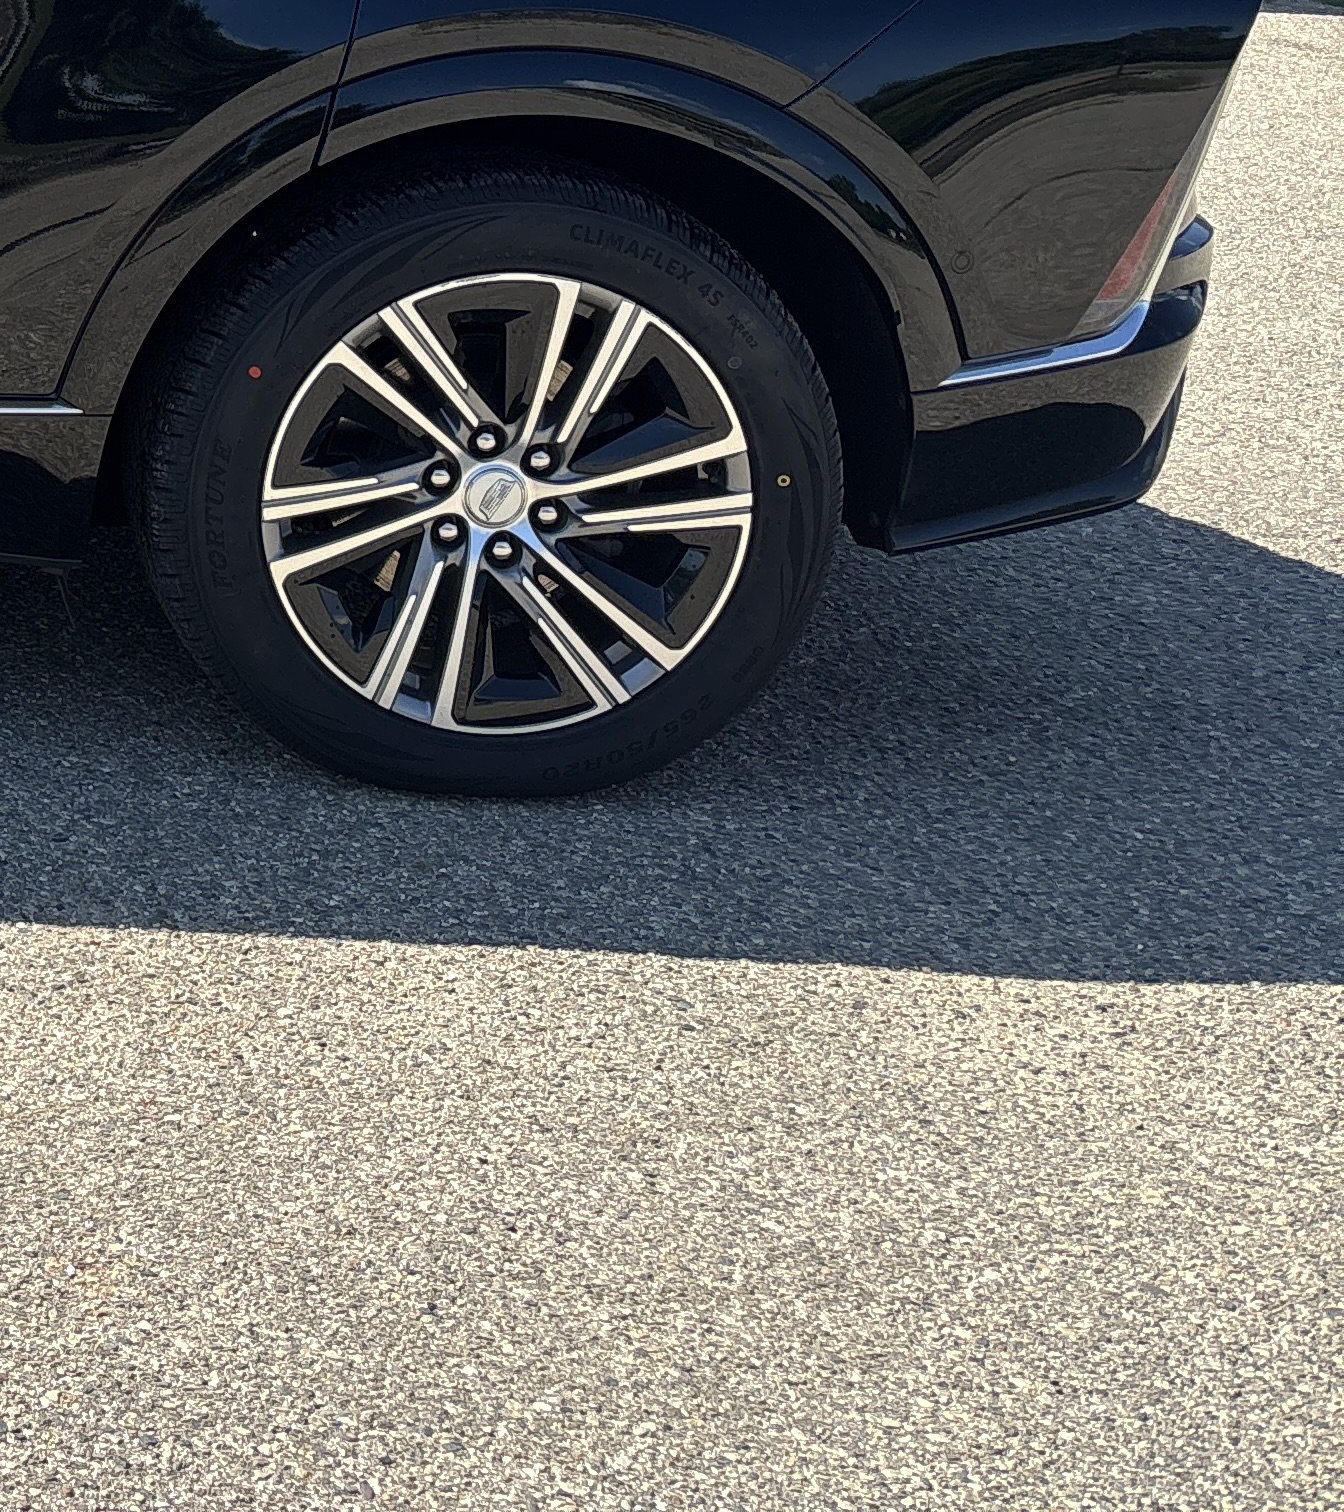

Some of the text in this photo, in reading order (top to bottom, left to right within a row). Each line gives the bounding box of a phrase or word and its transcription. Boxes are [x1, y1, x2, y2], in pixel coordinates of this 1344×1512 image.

[569, 224, 695, 285] CLIMAFLEX
[726, 313, 760, 350] FSR402
[205, 438, 233, 589] FORTUNE
